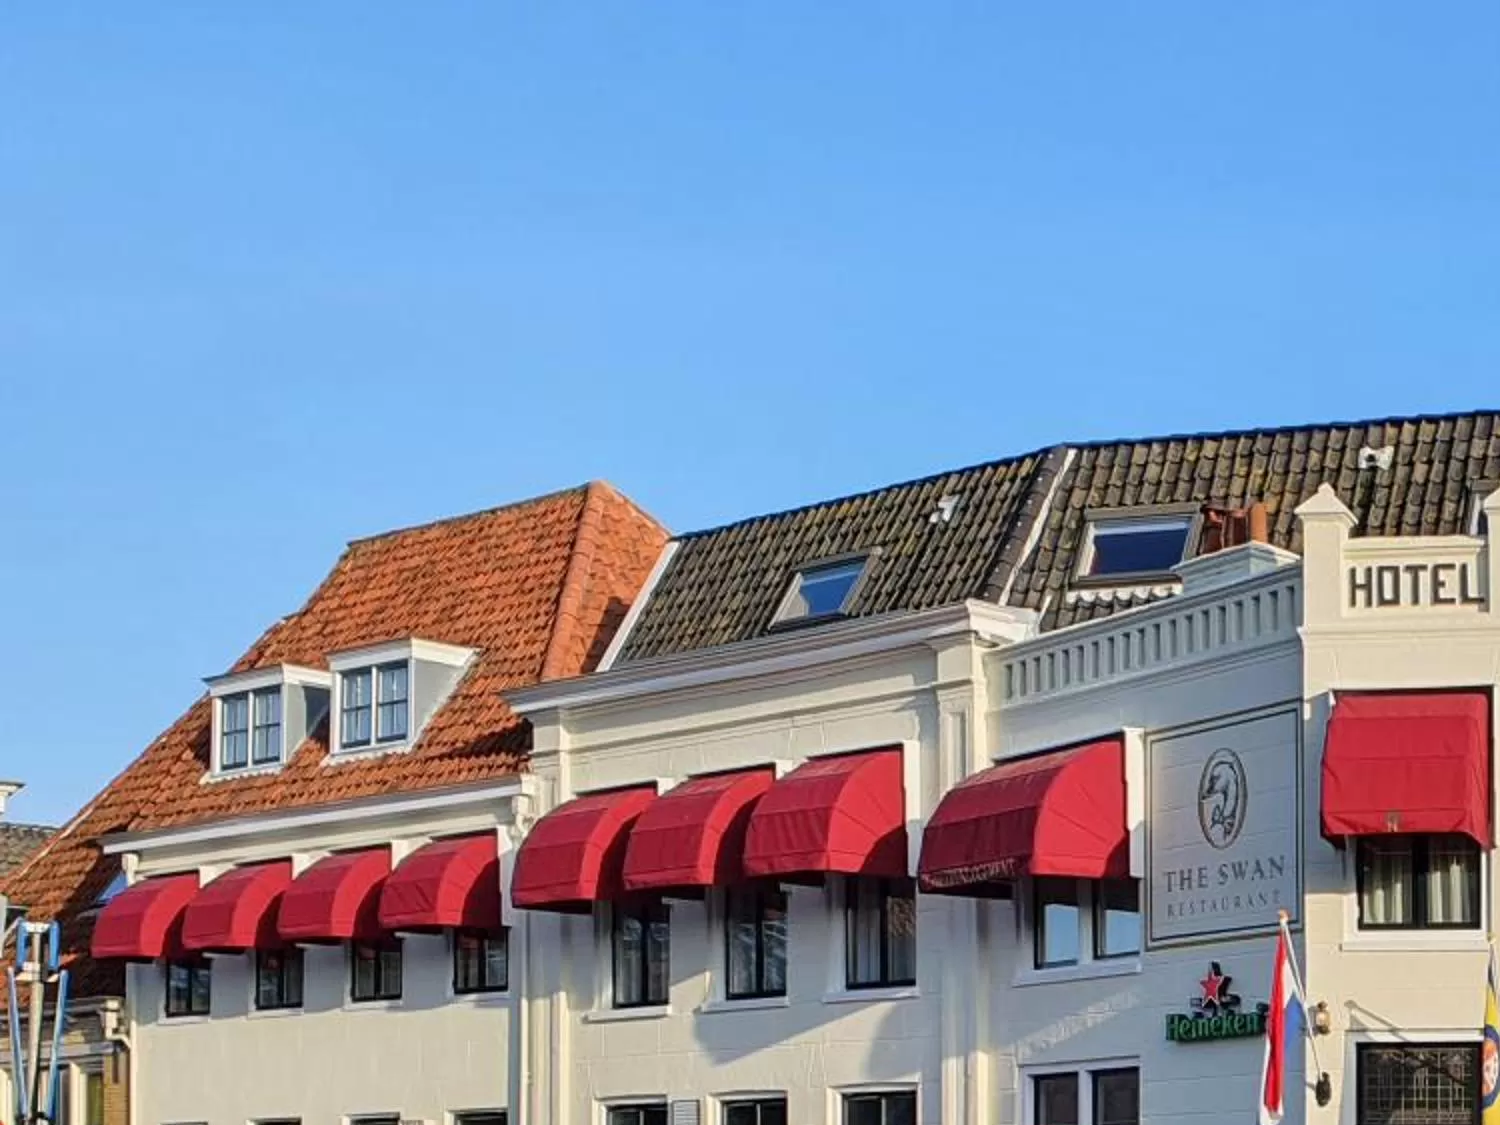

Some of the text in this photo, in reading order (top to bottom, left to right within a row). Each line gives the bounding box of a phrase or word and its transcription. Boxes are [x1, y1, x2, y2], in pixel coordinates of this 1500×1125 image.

[1349, 563, 1485, 608] HOTEL
[1165, 854, 1285, 893] THE SWAN
[1167, 889, 1281, 917] RESTAURANT
[1166, 1012, 1259, 1041] Heineken
